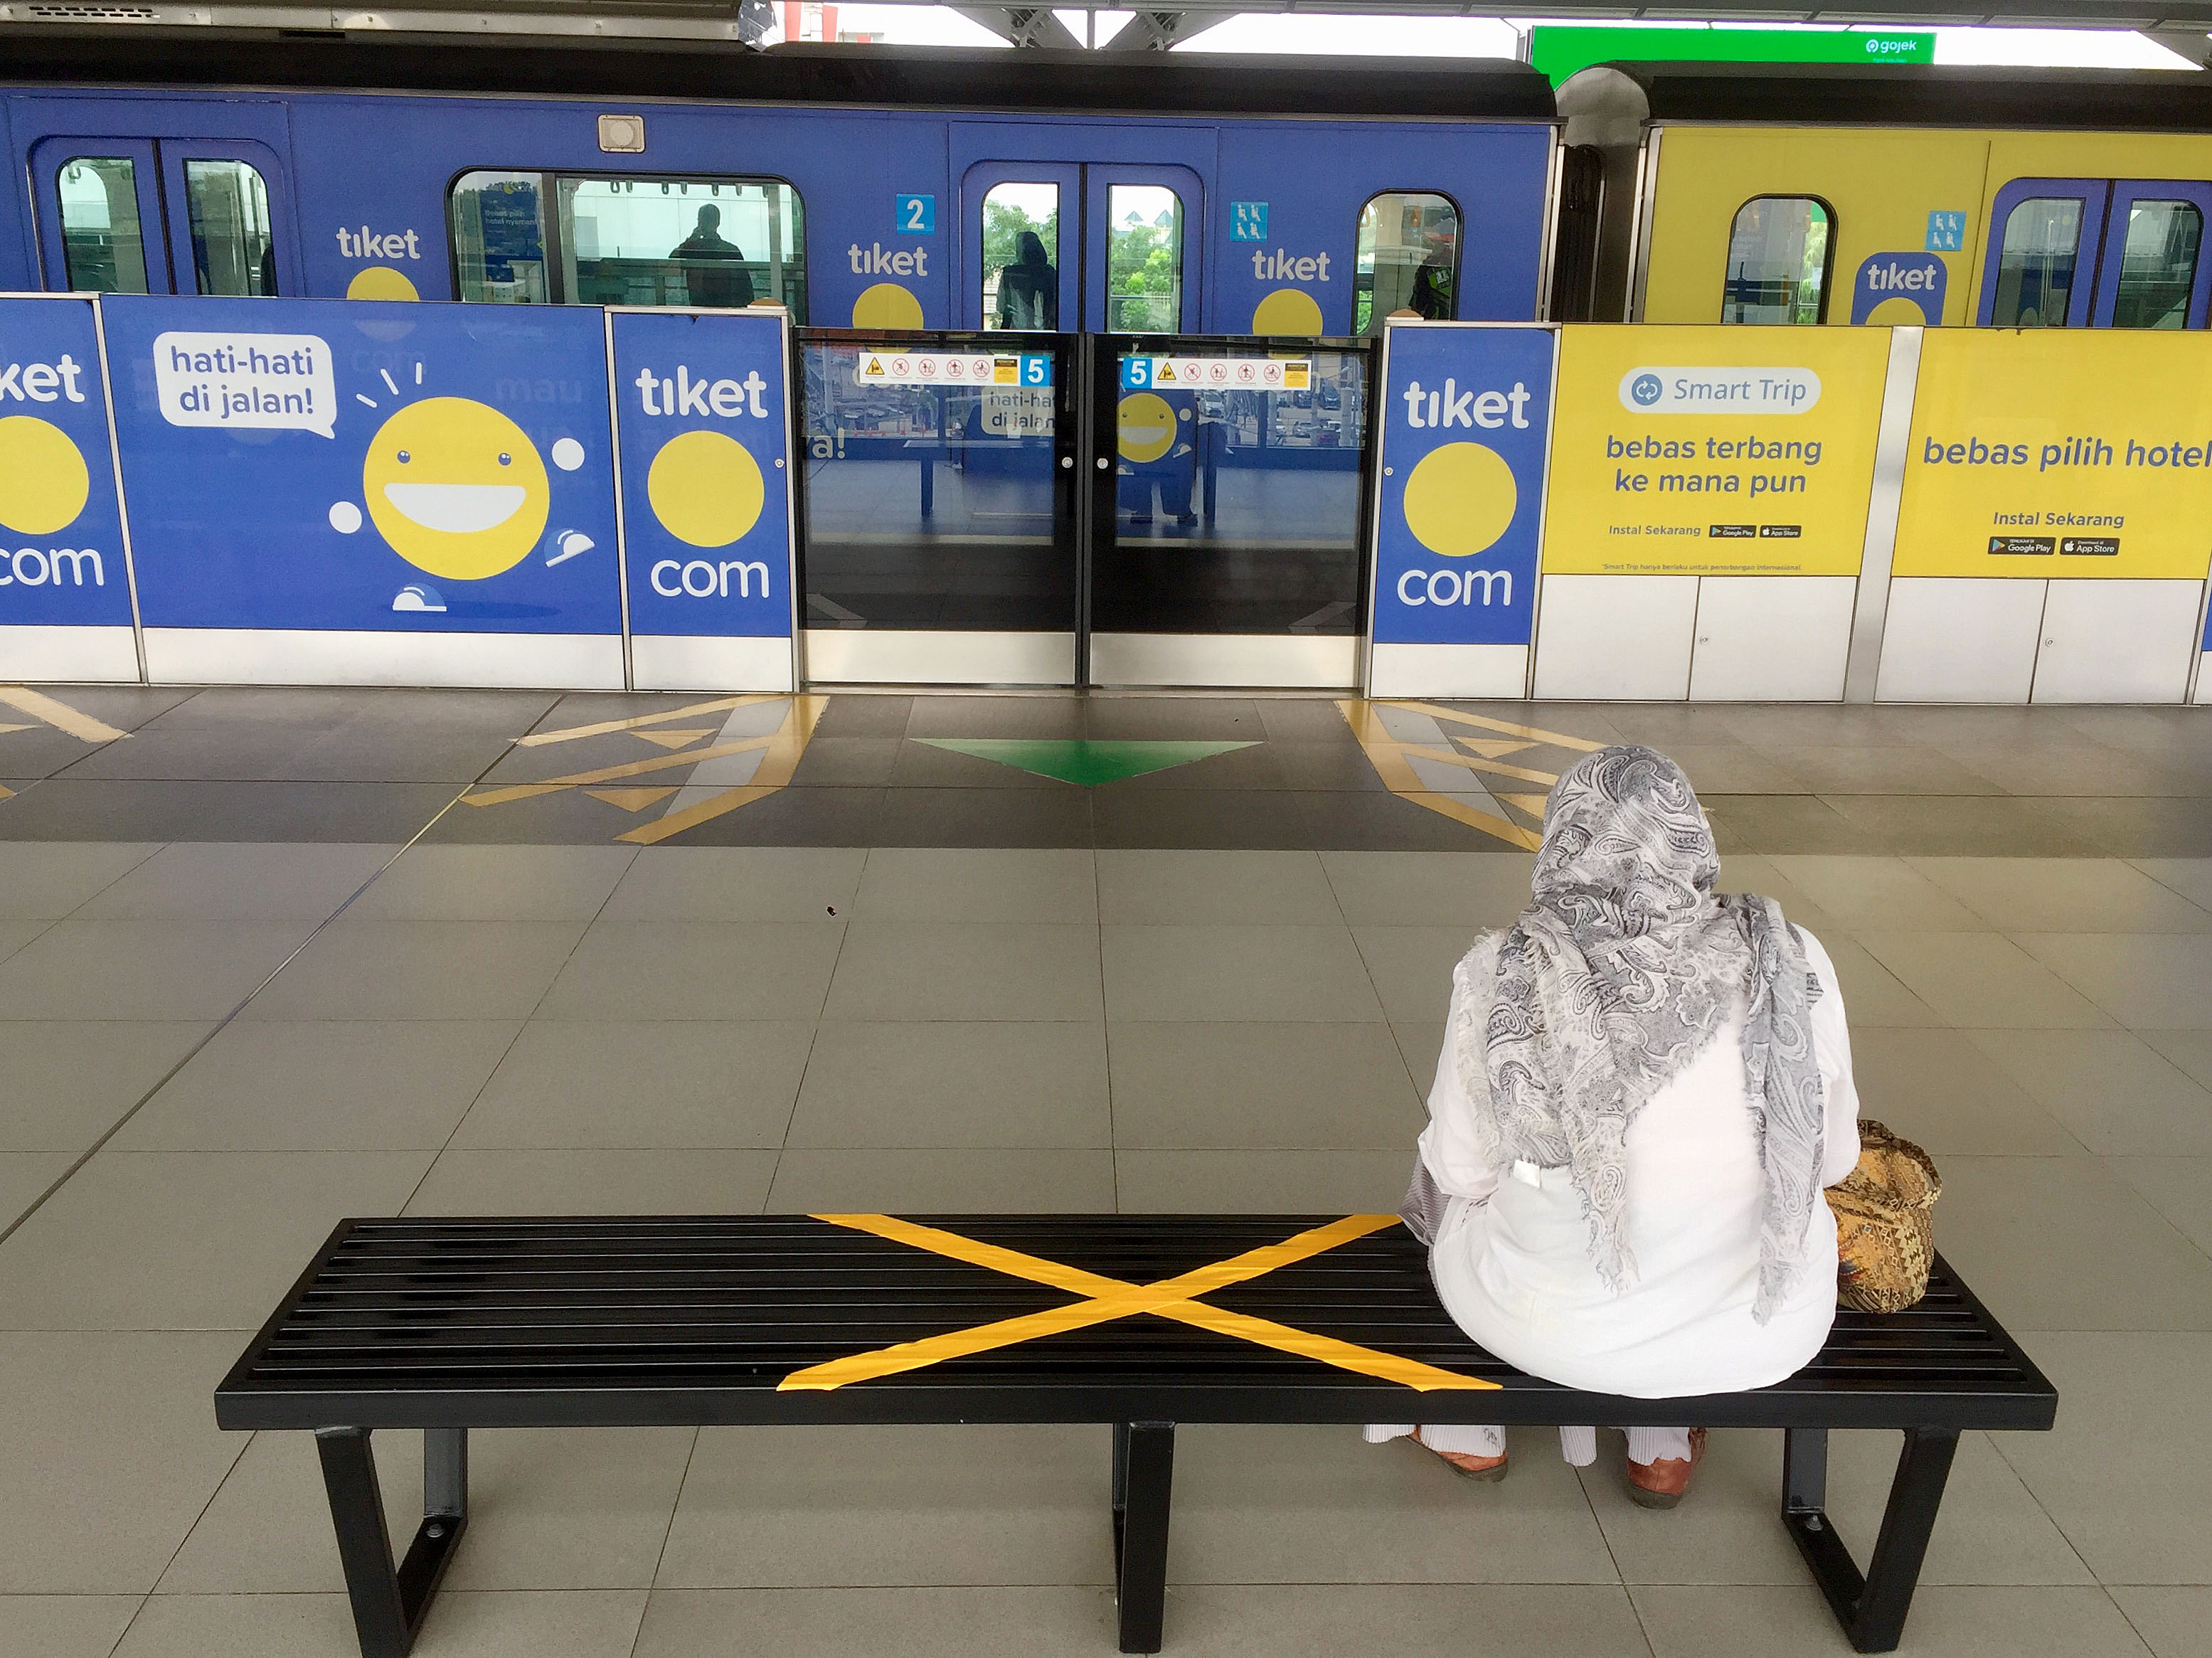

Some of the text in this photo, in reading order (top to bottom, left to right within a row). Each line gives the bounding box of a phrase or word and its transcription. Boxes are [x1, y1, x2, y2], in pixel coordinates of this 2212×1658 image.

[1880, 39, 1918, 53] gojek
[906, 198, 925, 230] 2
[336, 225, 420, 260] tiket
[848, 242, 929, 277] tiket
[1252, 248, 1331, 282] tiket
[1867, 262, 1937, 292] tiket
[171, 345, 314, 376] hati-hati
[1027, 358, 1044, 383] 5
[1130, 360, 1147, 386] 5
[179, 384, 314, 420] di jalan!
[634, 364, 769, 418] tiket
[1403, 377, 1531, 429] tiket
[1674, 378, 1807, 406] Smart Trip
[991, 411, 1007, 427] di
[805, 427, 846, 459] a!
[1606, 435, 1822, 466] bebas terbang
[1923, 436, 2212, 472] bebas pilih hotel
[1615, 468, 1807, 499] ke mana pun
[1609, 525, 1701, 537] Instal Sekarang
[1993, 511, 2125, 528] Instal Sekarang
[2007, 543, 2051, 553] Google Play
[2075, 545, 2093, 553] App
[650, 559, 770, 599] com
[1396, 569, 1513, 607] com
